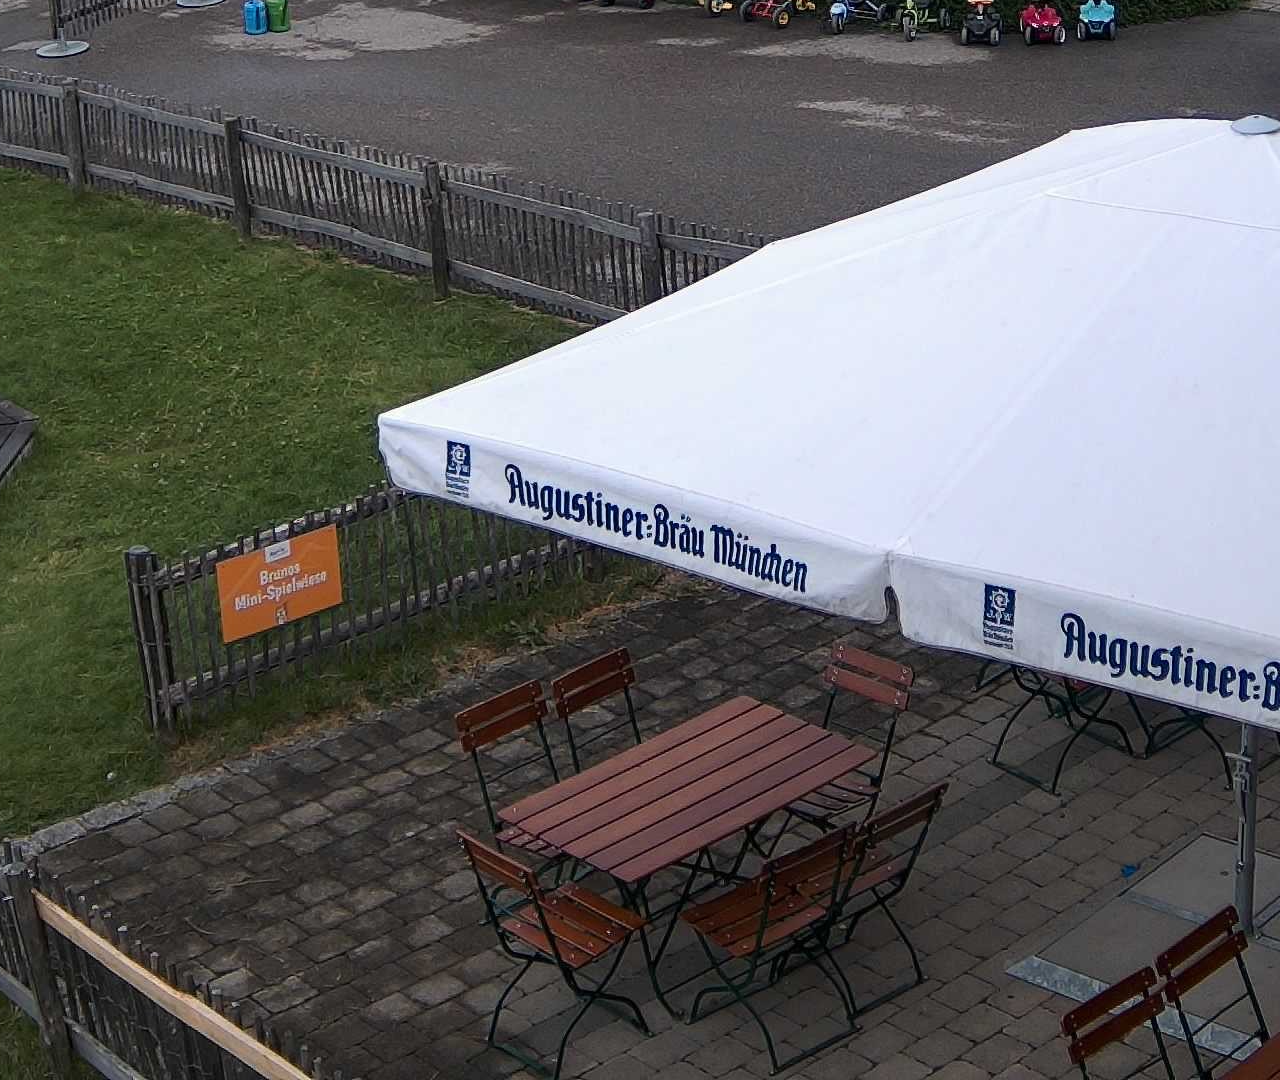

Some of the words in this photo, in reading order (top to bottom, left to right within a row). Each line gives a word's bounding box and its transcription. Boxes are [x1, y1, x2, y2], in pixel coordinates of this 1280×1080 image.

[259, 563, 301, 585] Brunos
[709, 524, 808, 593] München
[234, 571, 327, 611] Mini-Spielwiese
